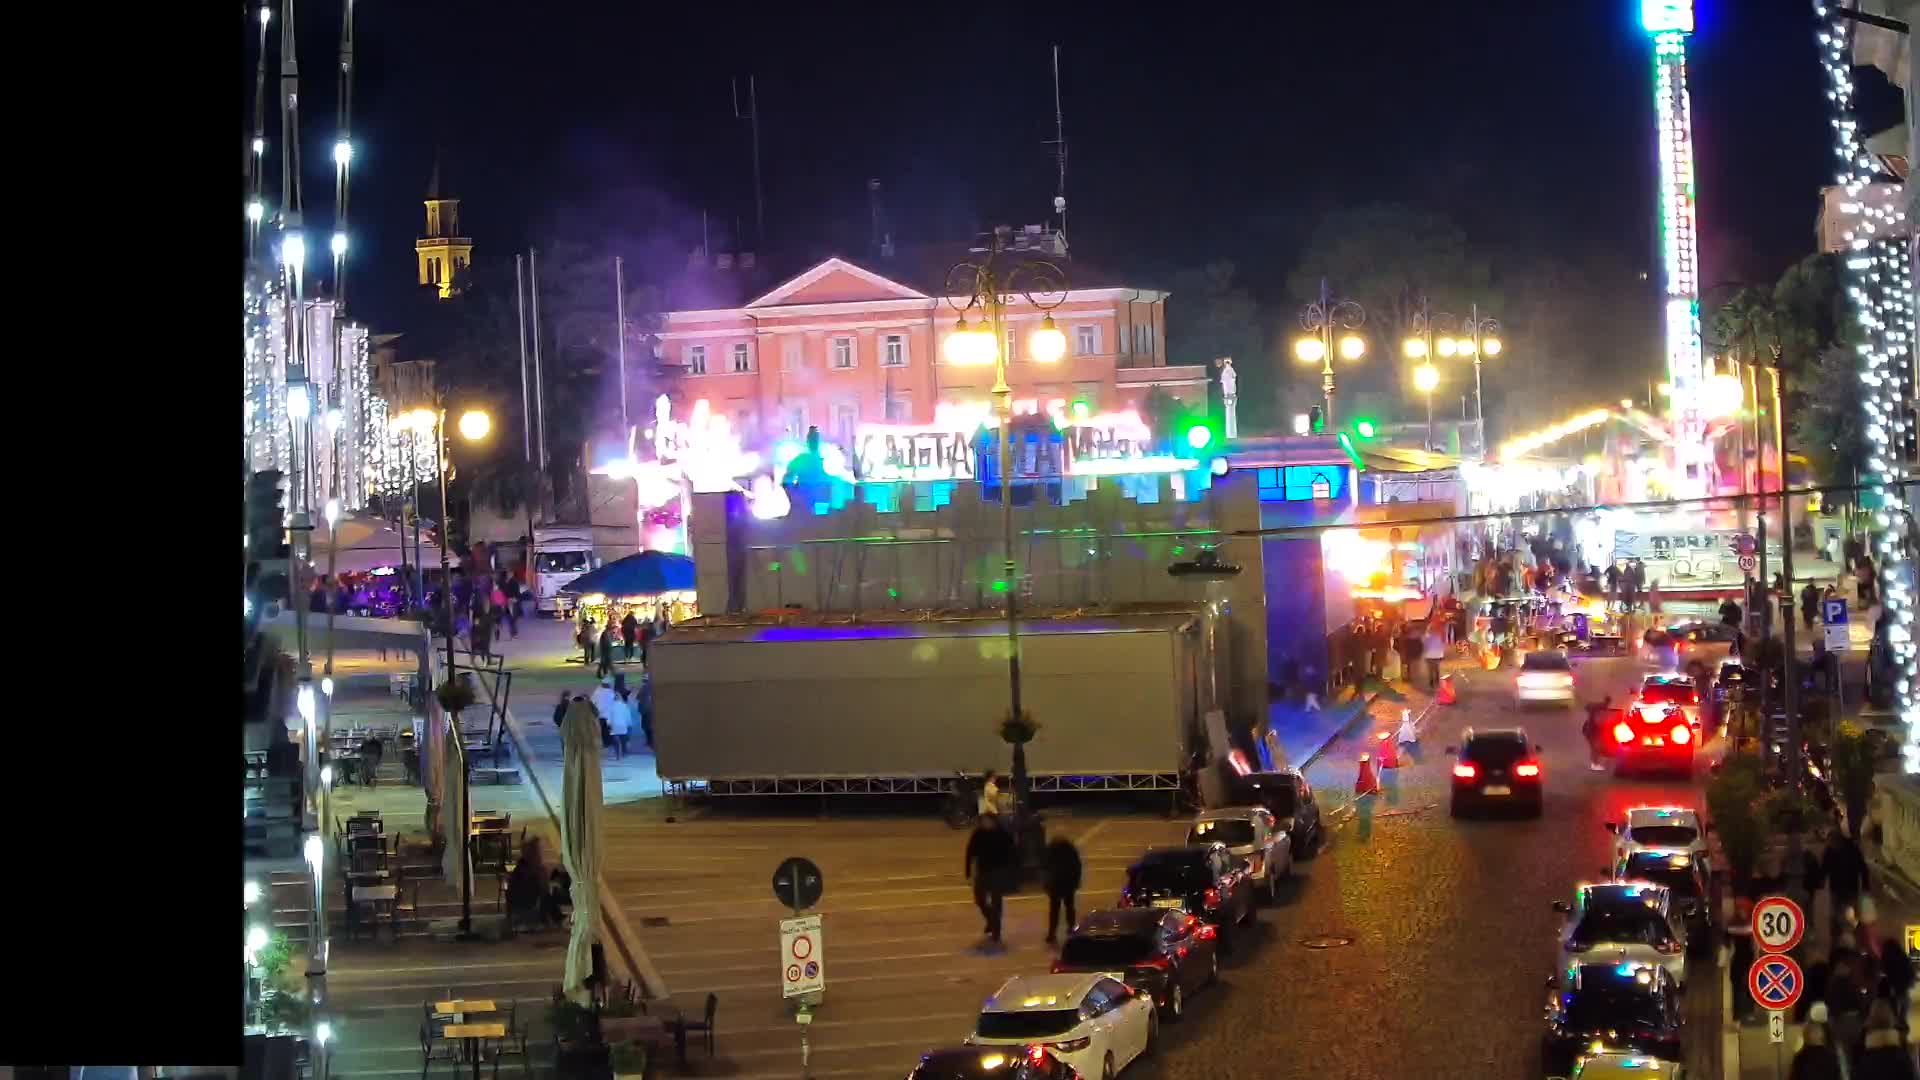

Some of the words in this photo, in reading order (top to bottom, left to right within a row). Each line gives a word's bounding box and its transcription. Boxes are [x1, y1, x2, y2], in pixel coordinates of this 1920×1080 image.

[1742, 558, 1753, 567] 20
[1826, 602, 1842, 622] P
[1762, 912, 1791, 937] 30
